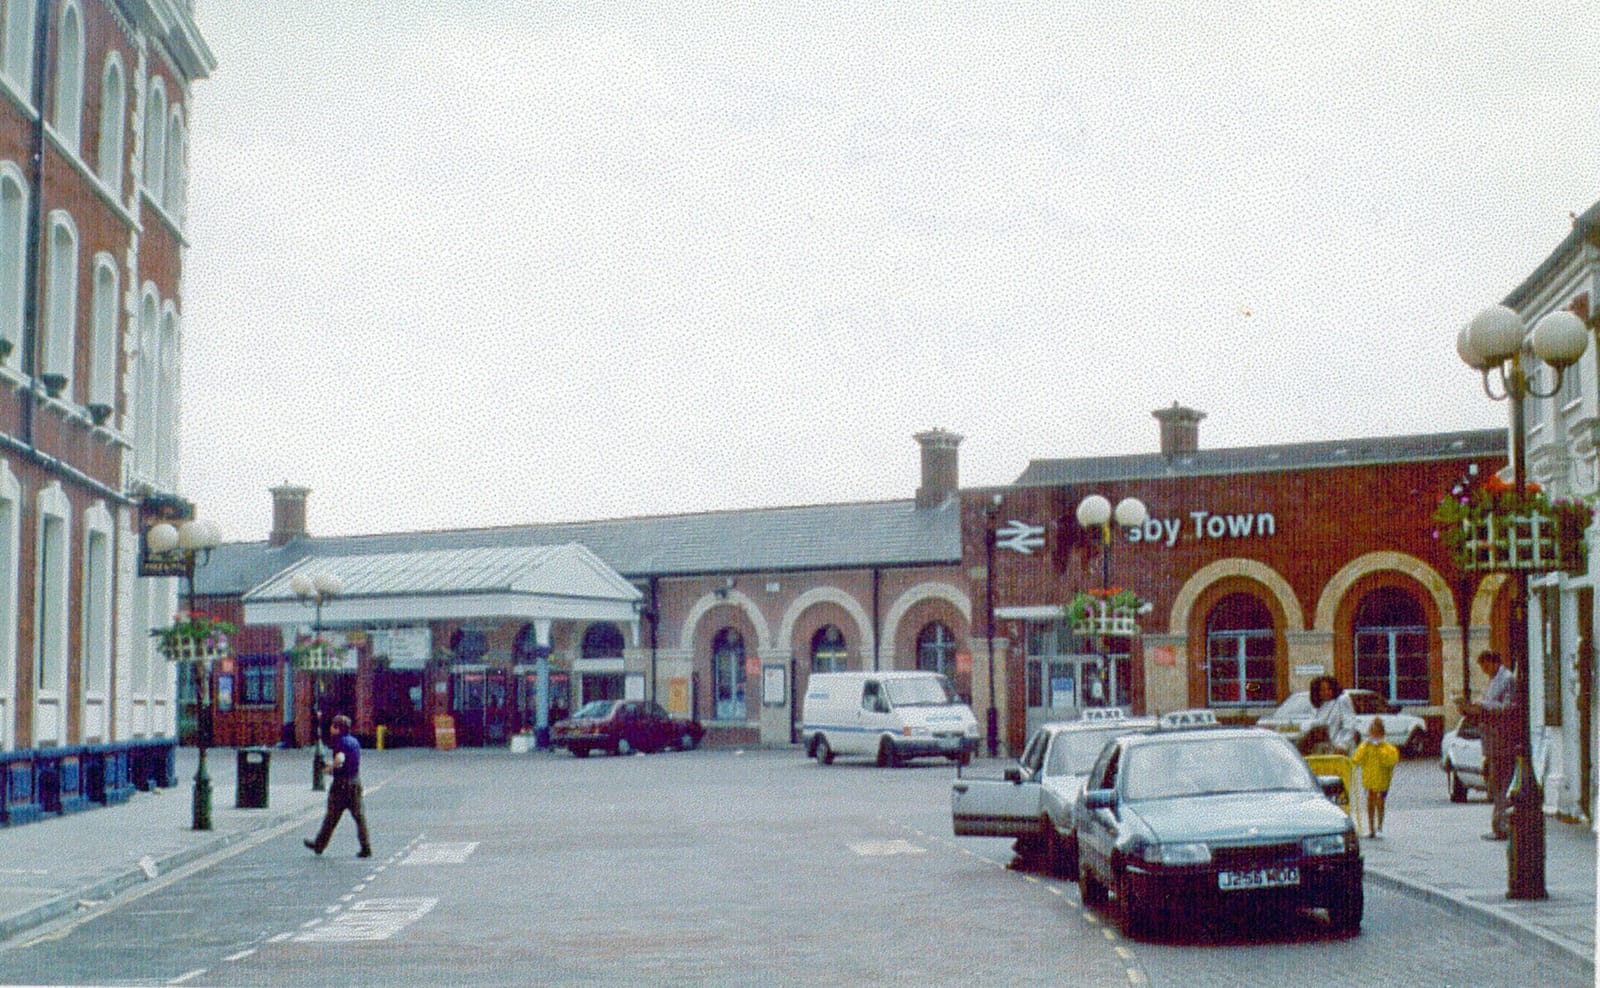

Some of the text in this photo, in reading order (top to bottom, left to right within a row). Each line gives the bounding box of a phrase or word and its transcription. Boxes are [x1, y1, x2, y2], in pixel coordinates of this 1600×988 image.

[1190, 511, 1275, 539] Town
[1087, 710, 1120, 720] TAXI
[1168, 712, 1212, 725] TAXI
